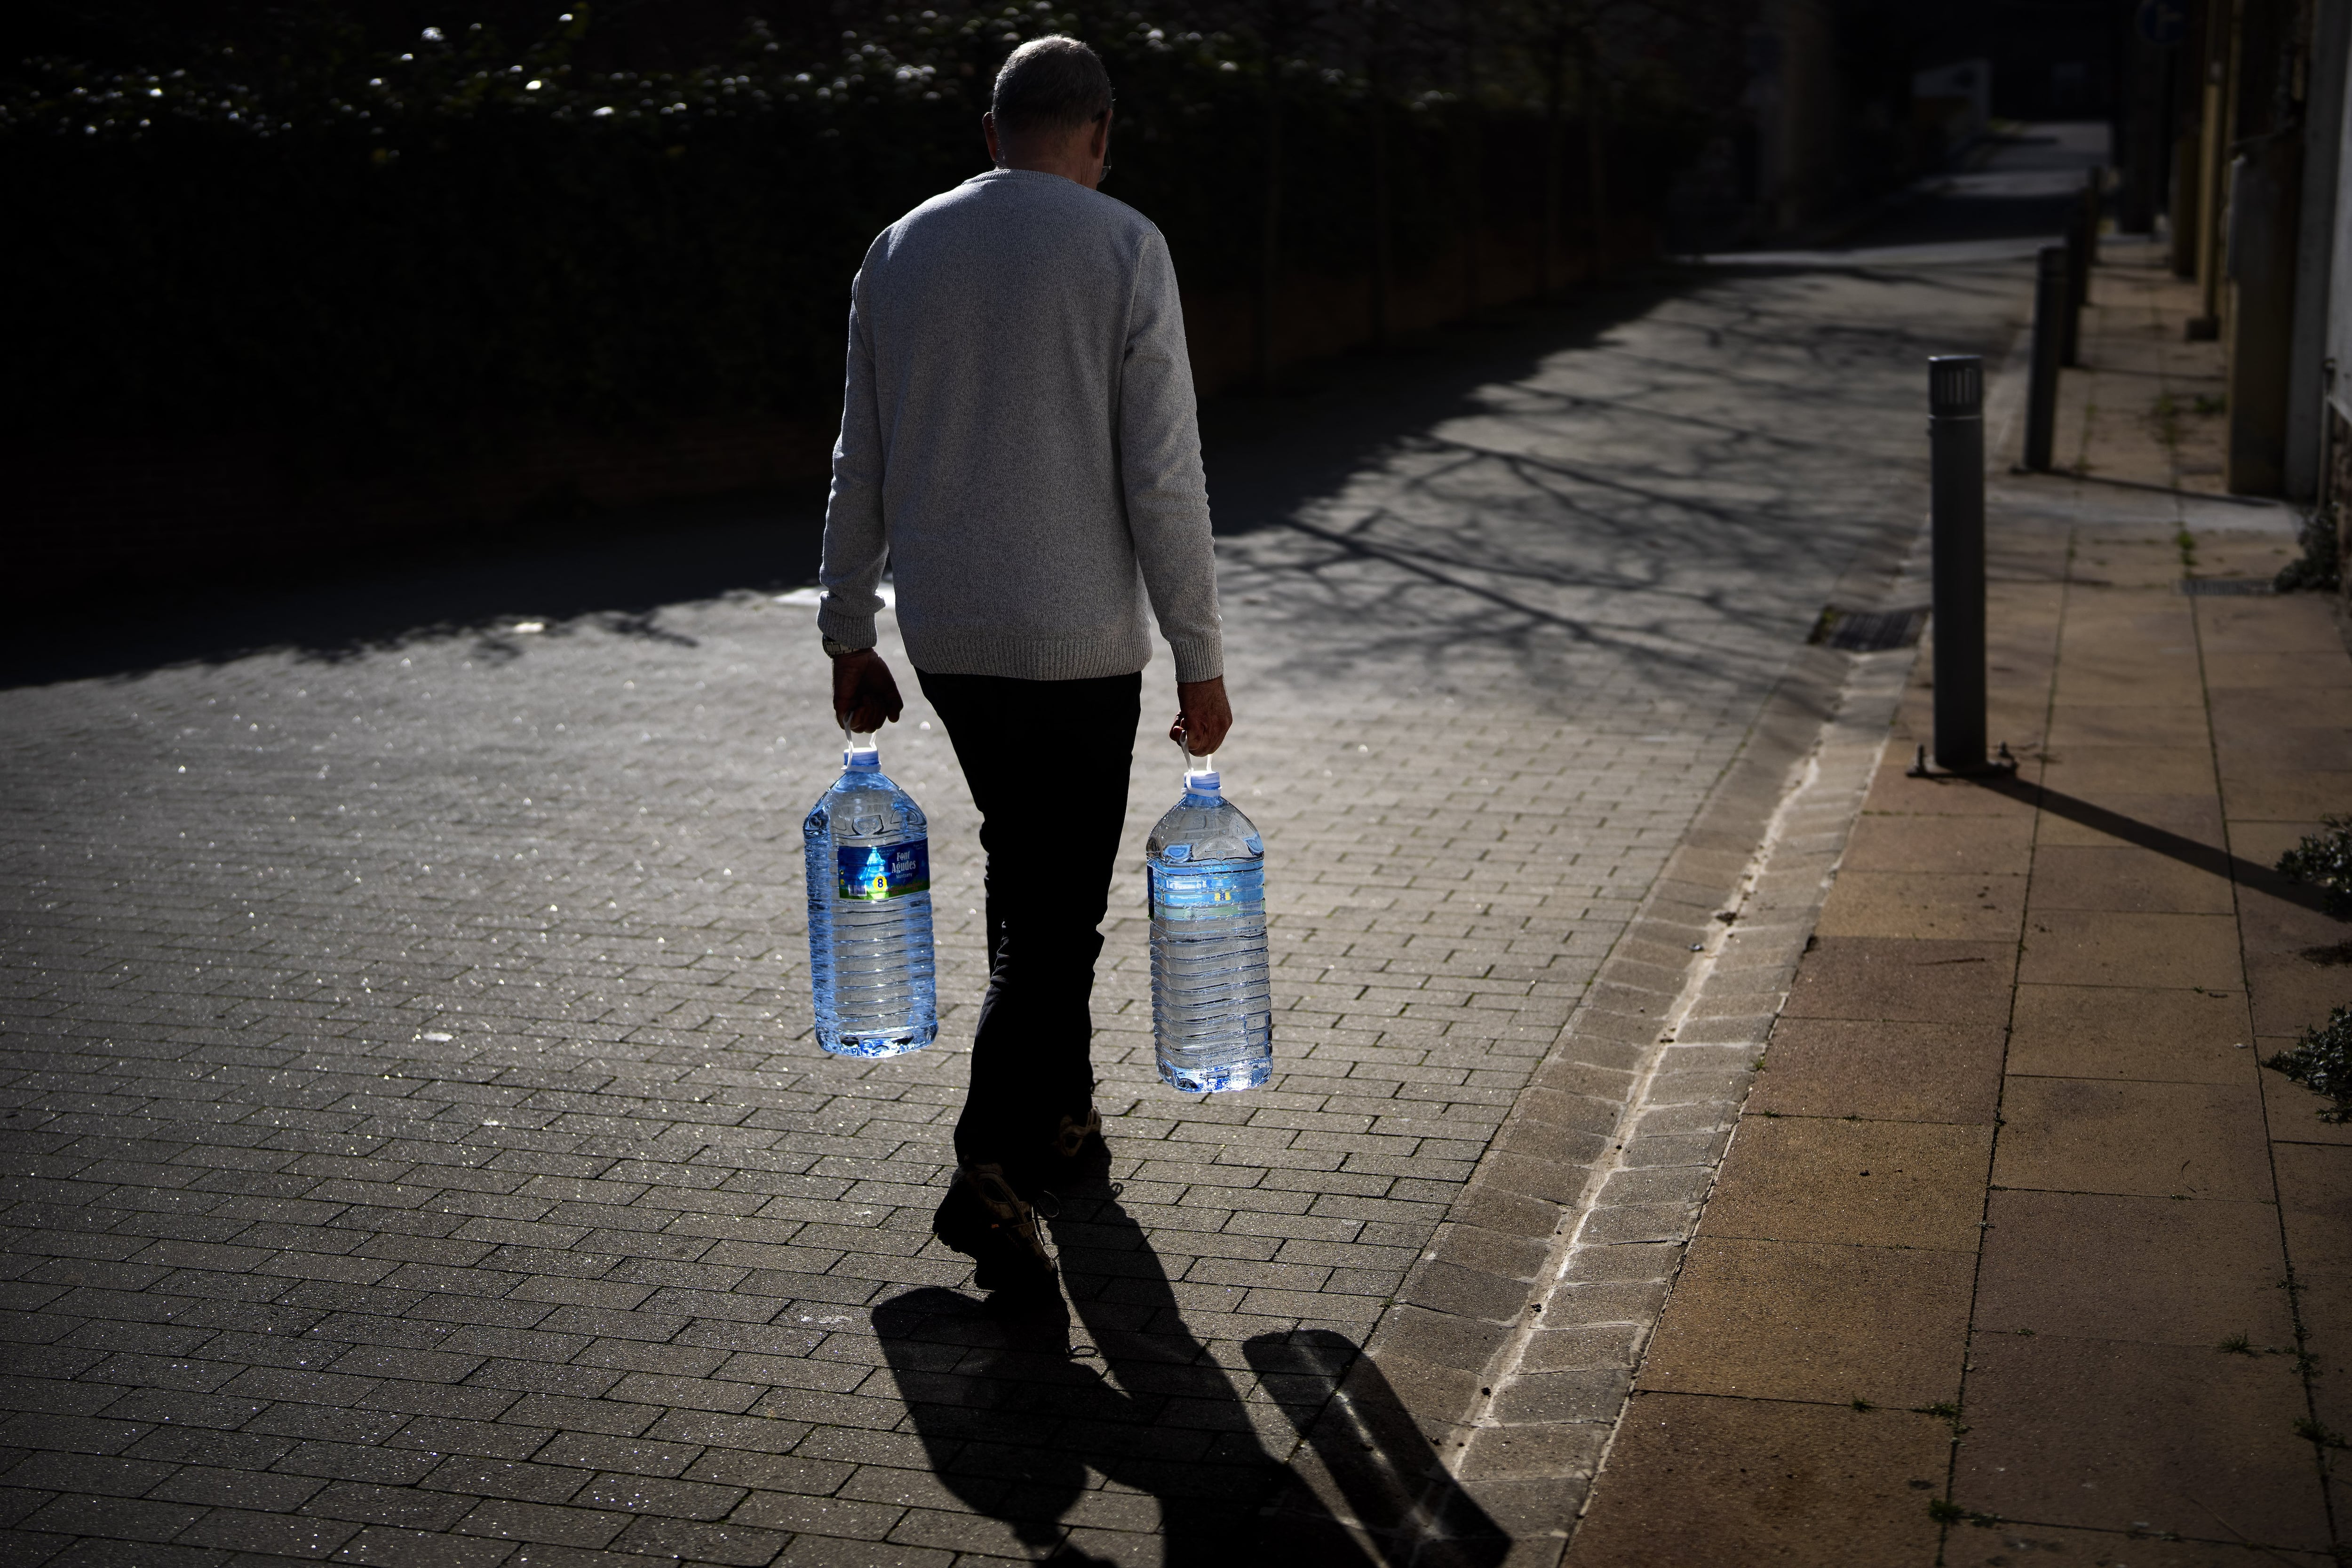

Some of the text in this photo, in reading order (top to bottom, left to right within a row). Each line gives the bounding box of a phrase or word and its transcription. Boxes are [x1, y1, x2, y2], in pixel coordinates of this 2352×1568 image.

[897, 851, 910, 861] Font
[891, 860, 916, 874] Agudes
[877, 878, 883, 888] 8
